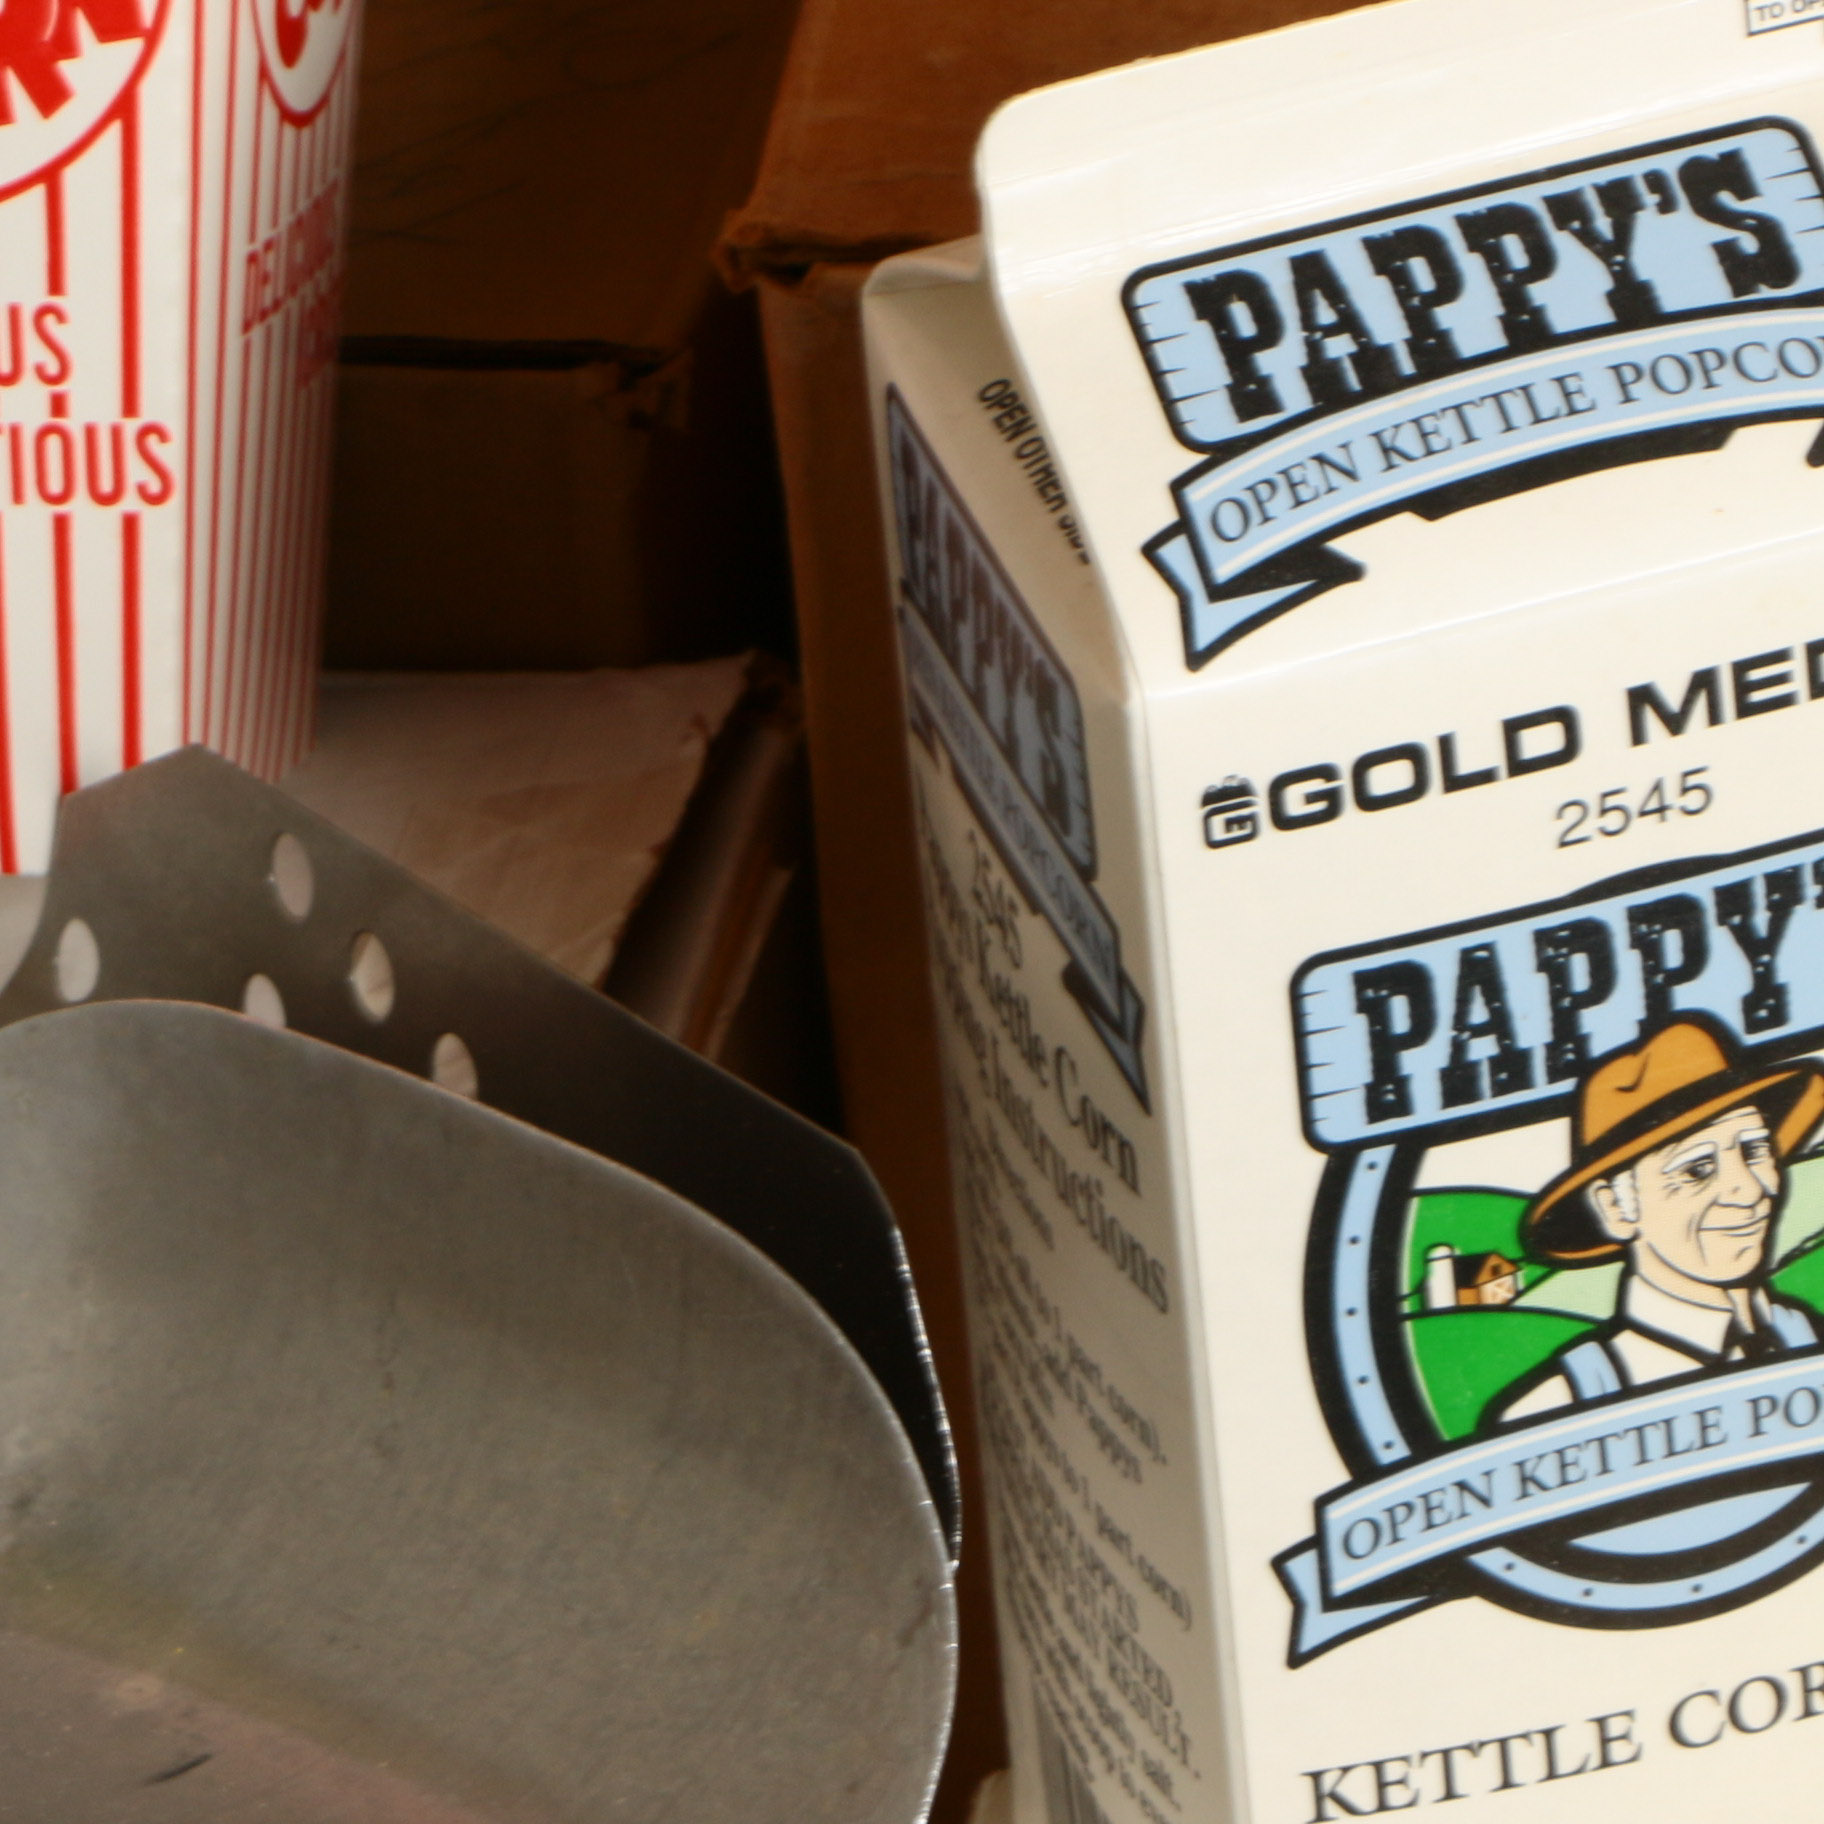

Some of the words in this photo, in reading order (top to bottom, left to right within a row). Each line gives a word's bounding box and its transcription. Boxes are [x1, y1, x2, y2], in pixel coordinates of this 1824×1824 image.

[1181, 148, 1801, 424] PAPPY'S
[978, 377, 1038, 443] OPEN
[1208, 443, 1362, 545] OPEN
[1376, 372, 1590, 474] KETTLE
[1268, 705, 1582, 832] GOLD
[1624, 637, 1824, 748] ME
[1554, 765, 1715, 849] 2545
[1054, 1044, 1142, 1198] Corn
[1341, 1469, 1494, 1562] OPEN
[1512, 1402, 1730, 1500] KETTLE
